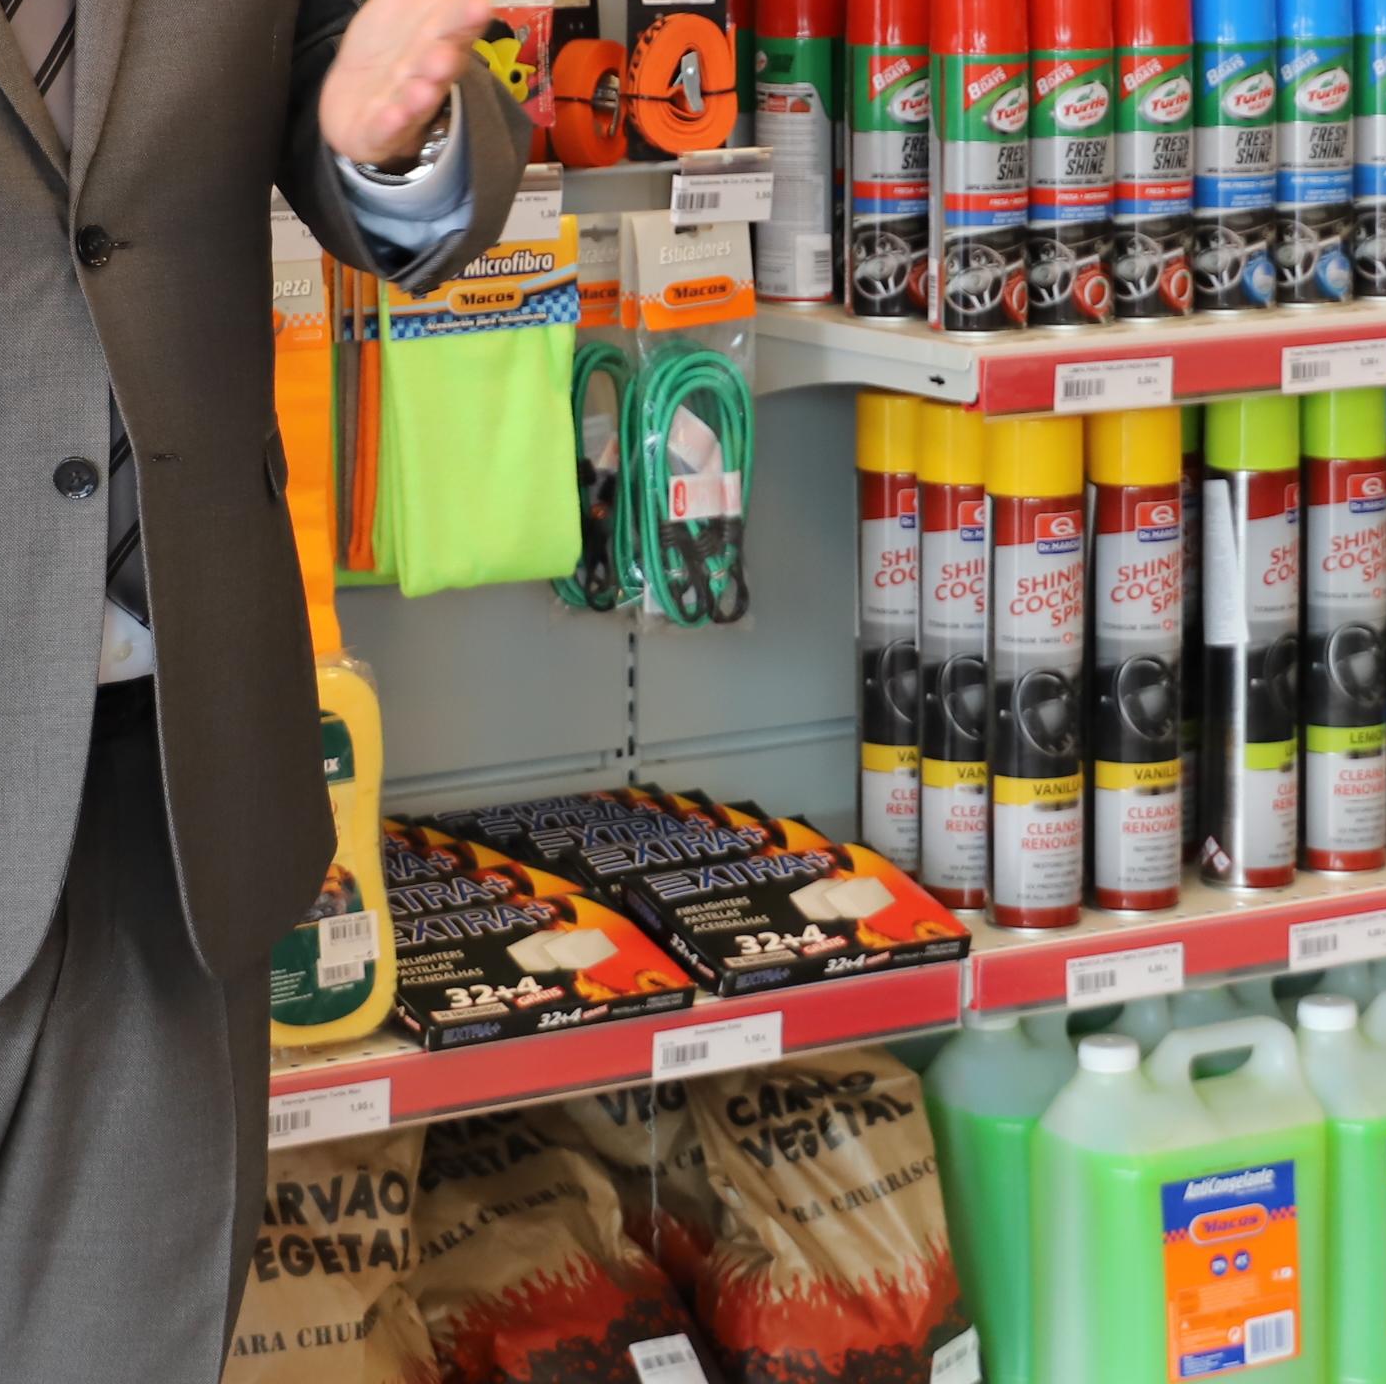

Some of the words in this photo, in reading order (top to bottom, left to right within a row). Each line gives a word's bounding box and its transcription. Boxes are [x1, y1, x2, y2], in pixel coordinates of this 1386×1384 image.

[1236, 130, 1272, 146] FRESH
[1310, 127, 1347, 142] FRESH
[1066, 141, 1107, 158] FRESH
[1153, 135, 1189, 153] FRESH
[1309, 143, 1347, 159] SHINE
[1153, 152, 1188, 170] SHINE
[1236, 147, 1271, 163] SHINE
[1066, 158, 1104, 175] SHINE
[659, 239, 732, 265] Esticadores
[463, 252, 554, 278] Microfibra
[460, 289, 515, 307] Macos
[672, 282, 728, 300] Macos
[643, 847, 835, 899] EXTRA+
[675, 896, 751, 917] FIRELIGHTERS
[683, 908, 742, 926] PASTILLAS
[693, 914, 770, 934] ACENDALHAS
[735, 924, 827, 955] 32+4
[824, 953, 866, 974] 32+4
[445, 976, 544, 1008] 32+4
[537, 1007, 582, 1029] 32+4
